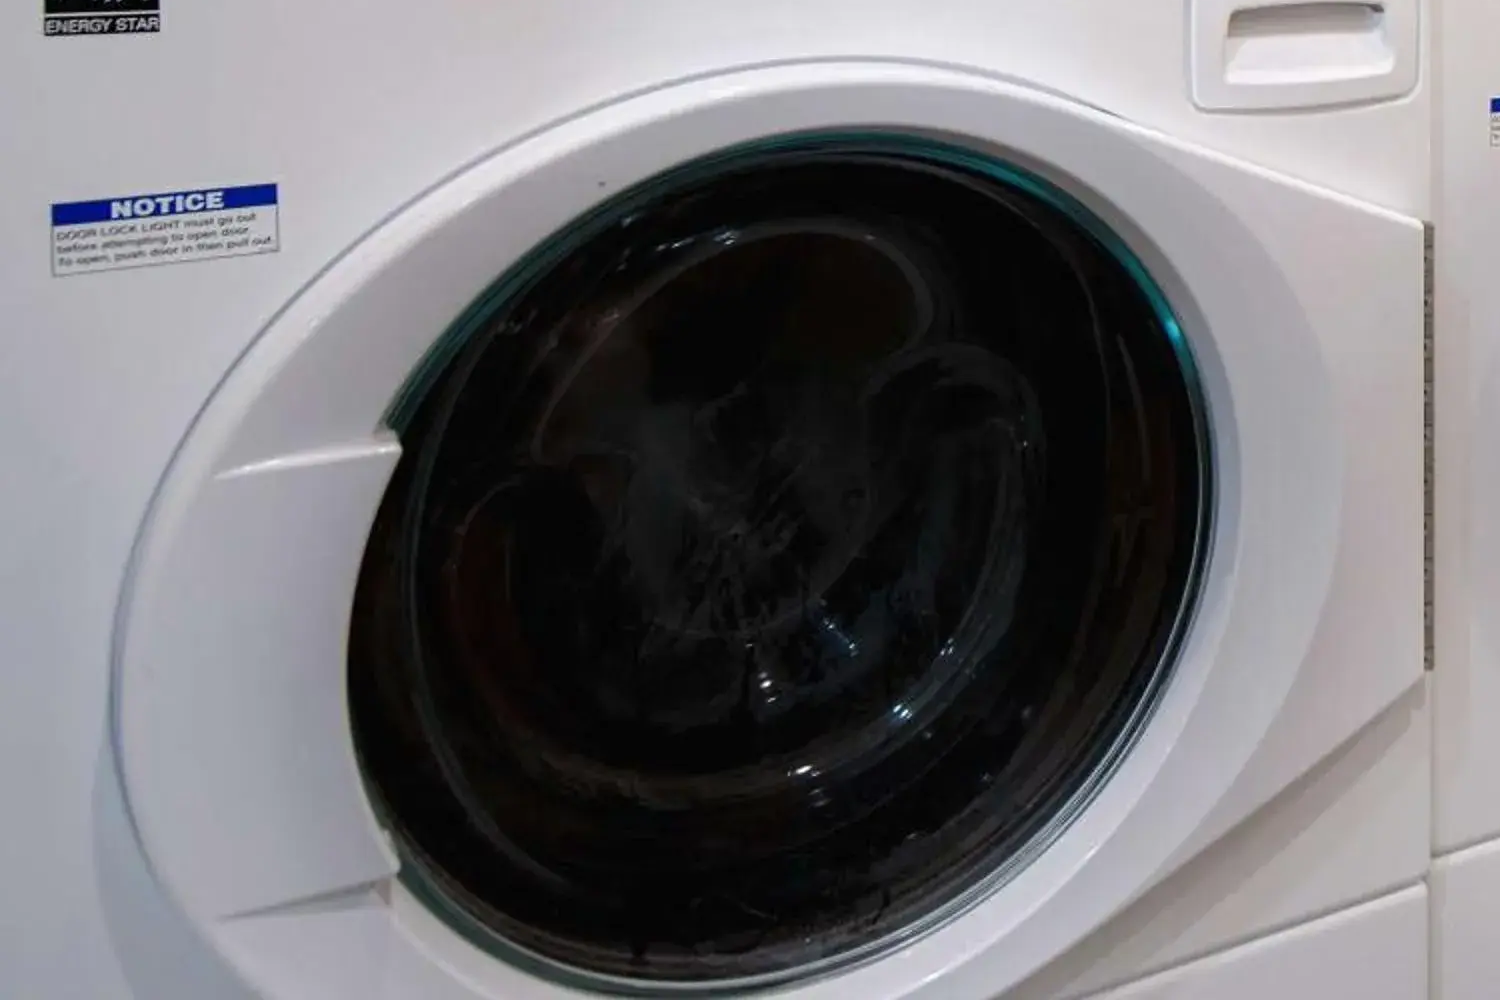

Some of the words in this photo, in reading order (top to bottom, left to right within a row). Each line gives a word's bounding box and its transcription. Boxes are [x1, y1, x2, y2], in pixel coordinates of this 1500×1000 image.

[45, 18, 110, 34] ENERGY
[118, 17, 160, 32] STAR
[111, 191, 224, 218] NOTICE
[56, 228, 97, 241] DOOR
[99, 224, 137, 237] LOCK
[141, 219, 180, 233] LIGHT
[184, 217, 215, 228] must
[217, 216, 233, 227] go
[237, 213, 256, 224] out
[56, 241, 99, 255] before
[101, 234, 168, 252] attempting
[171, 232, 185, 242] to
[187, 229, 217, 242] open
[221, 226, 249, 237] door
[114, 248, 147, 263] push
[149, 245, 178, 257] door
[181, 244, 192, 254] in
[196, 239, 224, 251] then
[226, 237, 249, 251] pull
[251, 235, 272, 246] out
